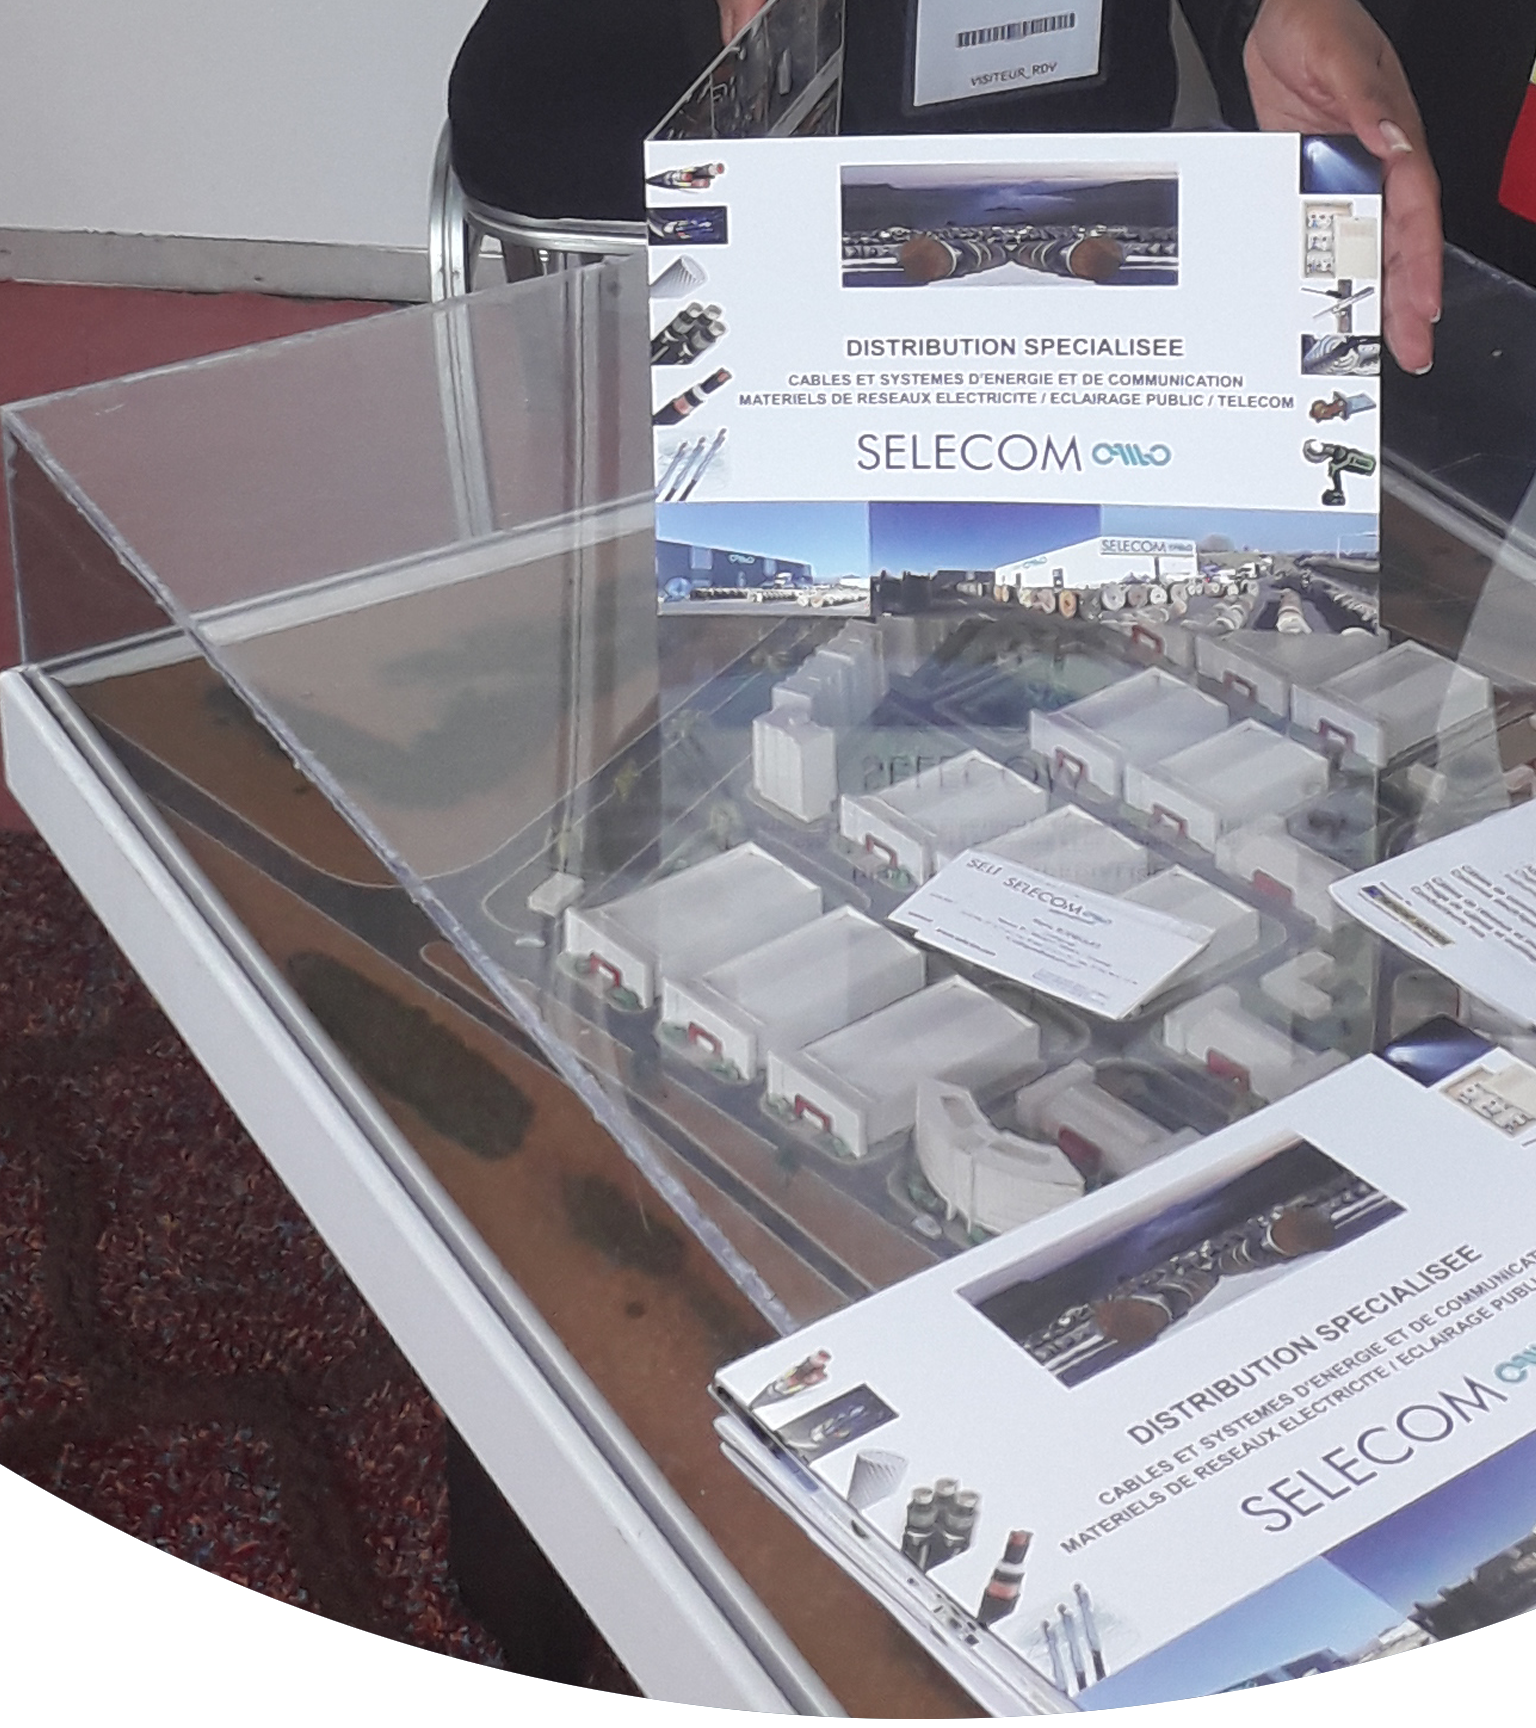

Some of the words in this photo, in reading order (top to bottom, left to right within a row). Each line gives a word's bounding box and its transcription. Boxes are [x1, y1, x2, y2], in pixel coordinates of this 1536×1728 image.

[847, 338, 1015, 357] DISTRIBUTION
[1024, 338, 1184, 357] SPECIALISEE
[788, 373, 851, 386] CABLES
[856, 374, 875, 385] ET
[880, 373, 963, 385] SYSTEMES
[969, 373, 1054, 385] D'ENERGIE
[1058, 373, 1077, 385] ET
[1083, 373, 1103, 385] DE
[1108, 374, 1244, 388] COMMUNICATION
[739, 393, 826, 405] MATERIELS
[831, 393, 853, 404] DE
[857, 392, 931, 404] RESEAUX
[936, 392, 1037, 404] ELECTRICITE
[1040, 392, 1046, 404] /
[1050, 392, 1141, 405] ECLAIRAGE
[1146, 394, 1203, 407] PUBLIC
[1207, 395, 1213, 407] /
[1218, 395, 1294, 409] TELECOM
[857, 433, 1082, 471] SELECOM
[1101, 539, 1167, 553] SELECOM
[1126, 1335, 1319, 1447] DISTRIBUTION
[1315, 1243, 1483, 1342] SPECIALISEE
[1098, 1460, 1175, 1506] CABLES
[1172, 1443, 1200, 1465] ET
[1199, 1393, 1295, 1451] SYSTEMES
[1292, 1342, 1388, 1397] D'ENERGIE
[1383, 1328, 1413, 1348] ET
[1408, 1313, 1438, 1334] DE
[1060, 1490, 1167, 1555] MATERIELS
[1163, 1475, 1197, 1496] DE
[1193, 1427, 1282, 1480] RESEAUX
[1279, 1363, 1391, 1433] ELECTRICITE
[1395, 1306, 1495, 1368] ECLAIRAGE
[1241, 1376, 1508, 1532] SELECOM
